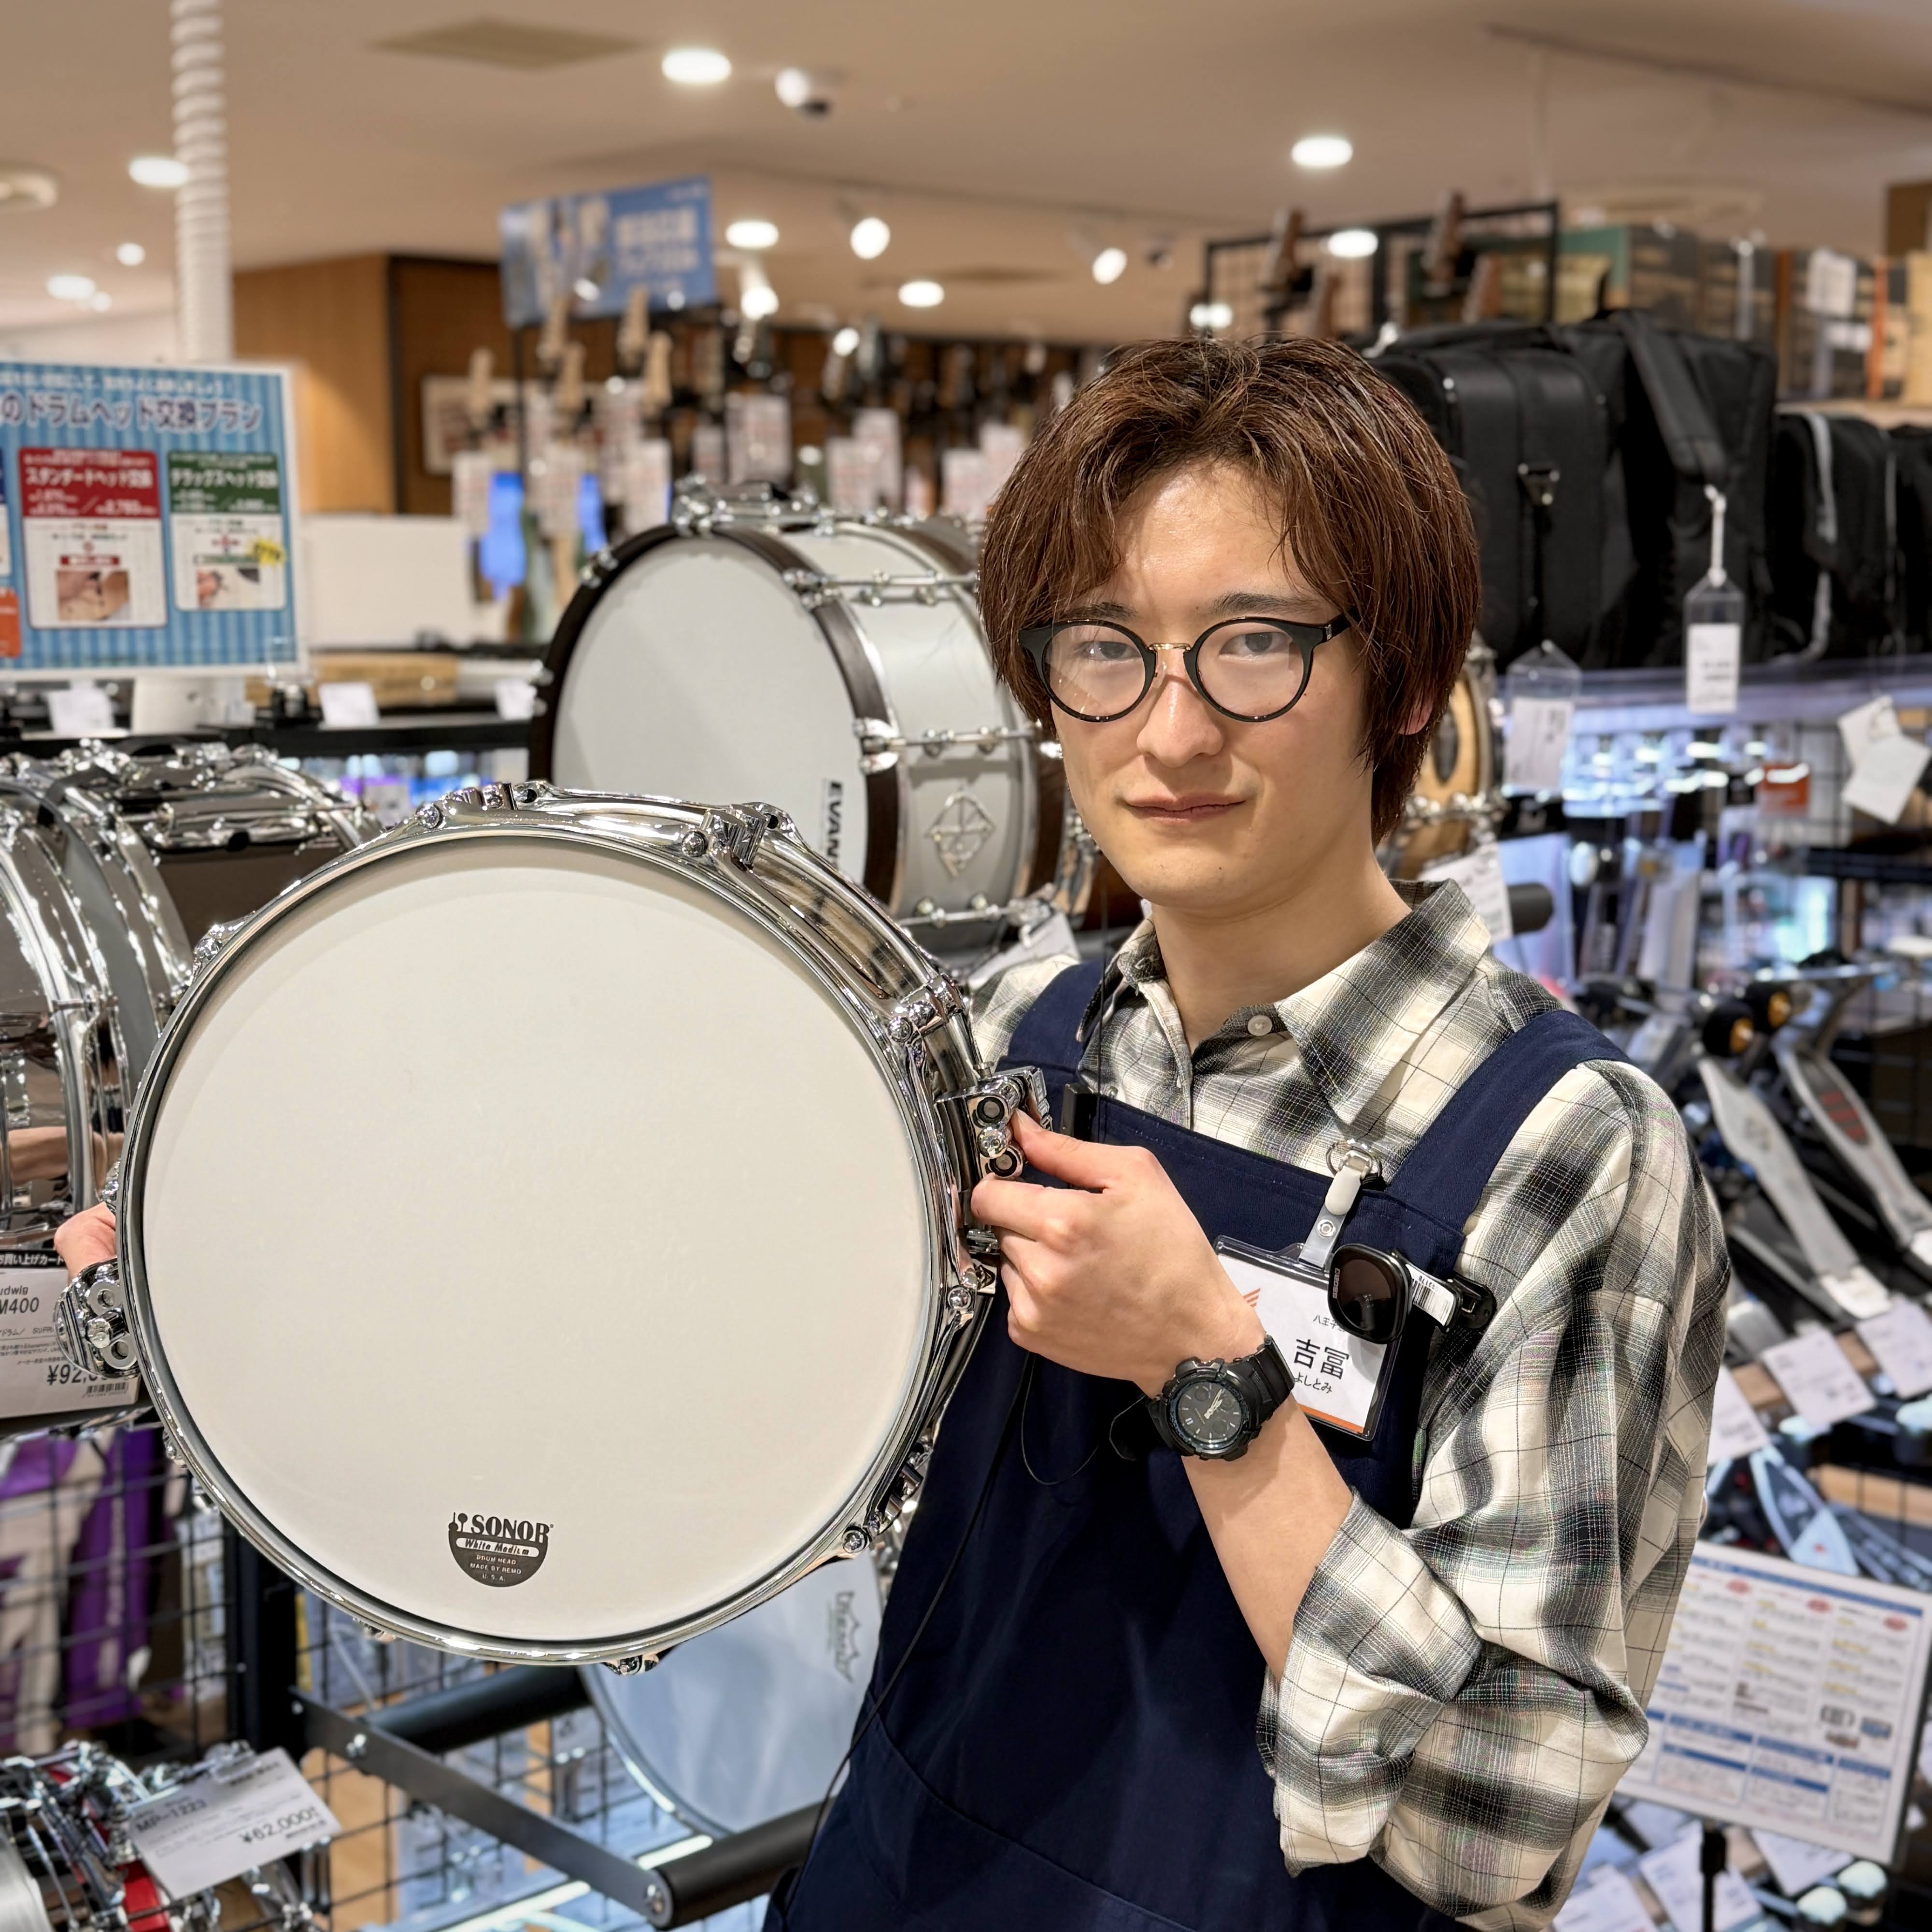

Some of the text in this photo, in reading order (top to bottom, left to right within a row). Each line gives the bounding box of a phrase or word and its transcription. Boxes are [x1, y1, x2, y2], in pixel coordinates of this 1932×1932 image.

[1313, 1315, 1346, 1333] 八王子
[1293, 1339, 1350, 1380] 吉冨
[1294, 1372, 1333, 1394] よしとみ
[470, 1514, 550, 1544] SONOR
[465, 1538, 530, 1556] White Medium
[476, 1554, 496, 1563] DRUM
[502, 1567, 522, 1575] REMO
